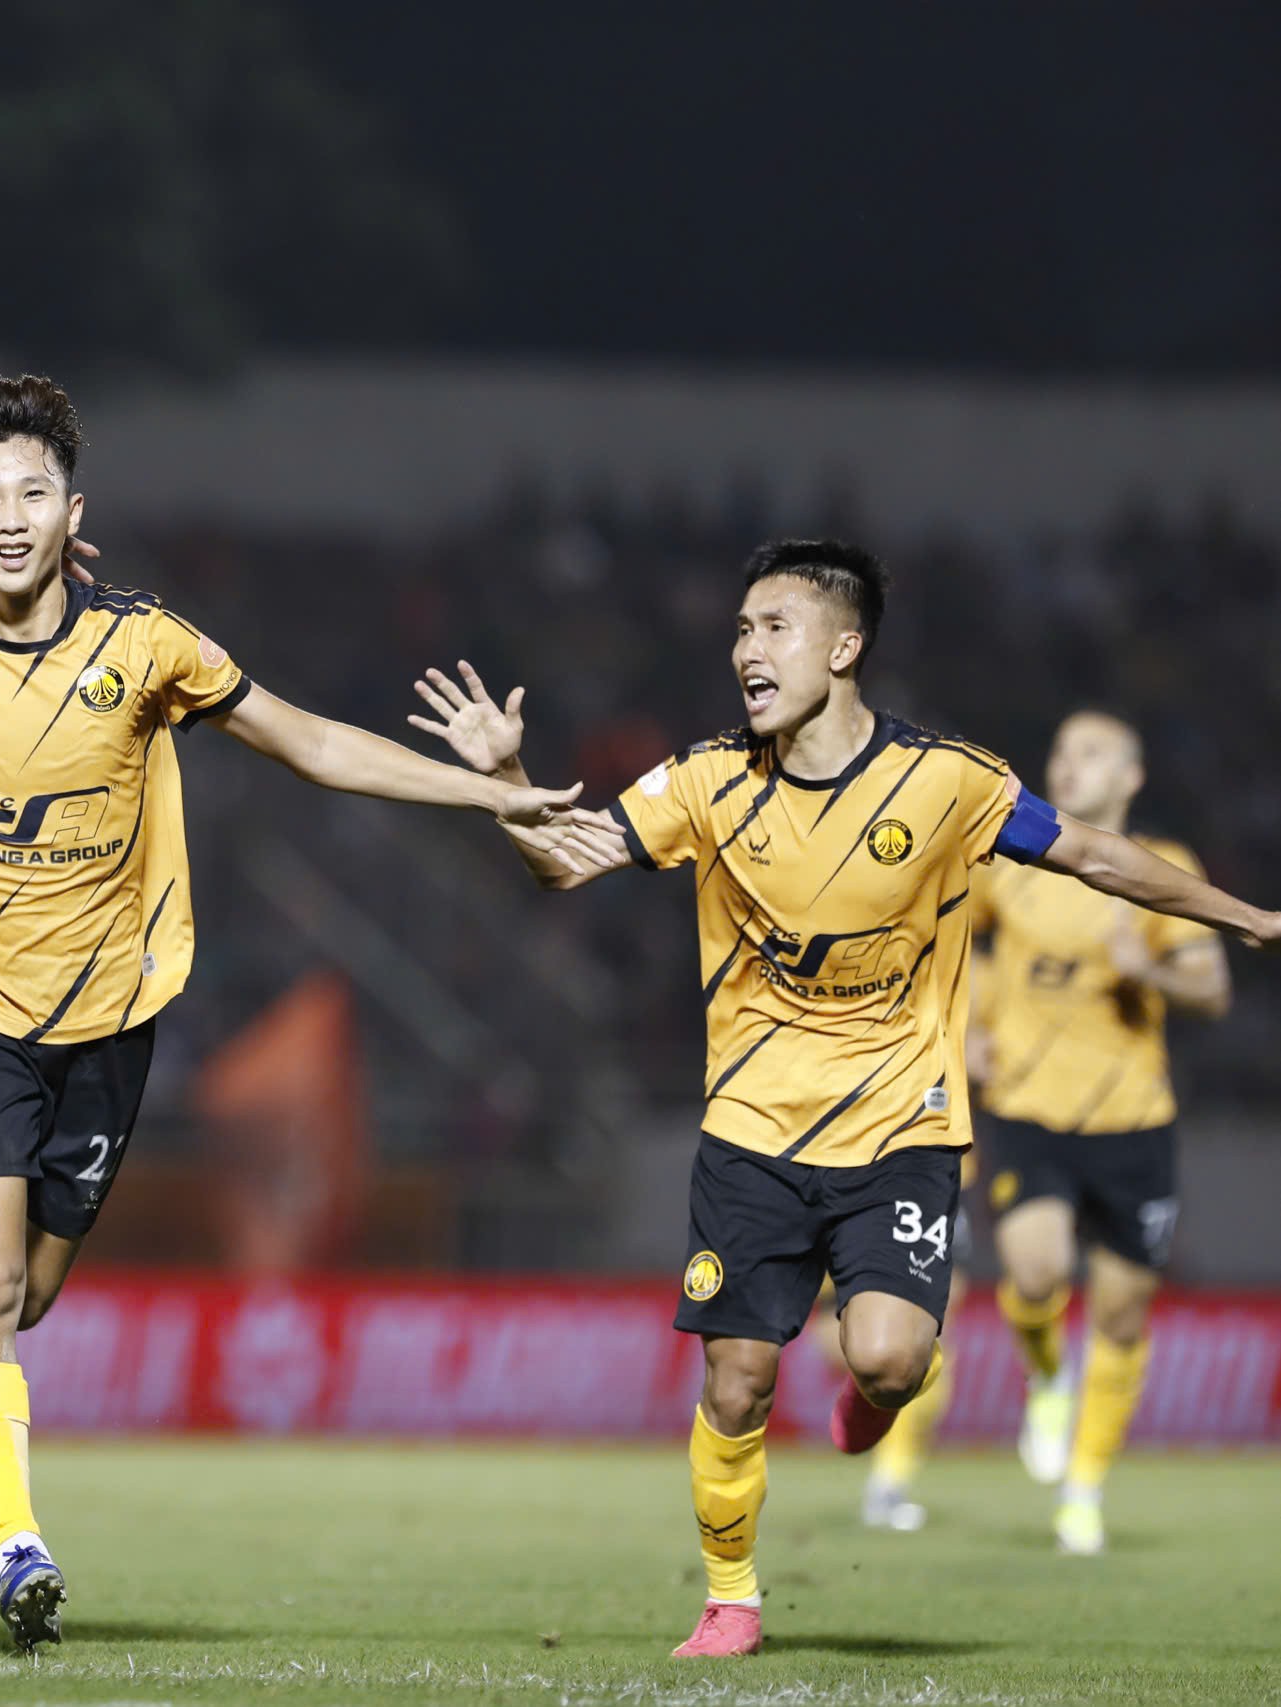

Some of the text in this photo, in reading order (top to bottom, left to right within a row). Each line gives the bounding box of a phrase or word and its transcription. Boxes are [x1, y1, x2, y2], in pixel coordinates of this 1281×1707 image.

[28, 851, 44, 864] A
[50, 838, 123, 864] GROUP
[814, 985, 829, 997] A
[833, 971, 903, 998] GROUP
[892, 1200, 948, 1261] 34
